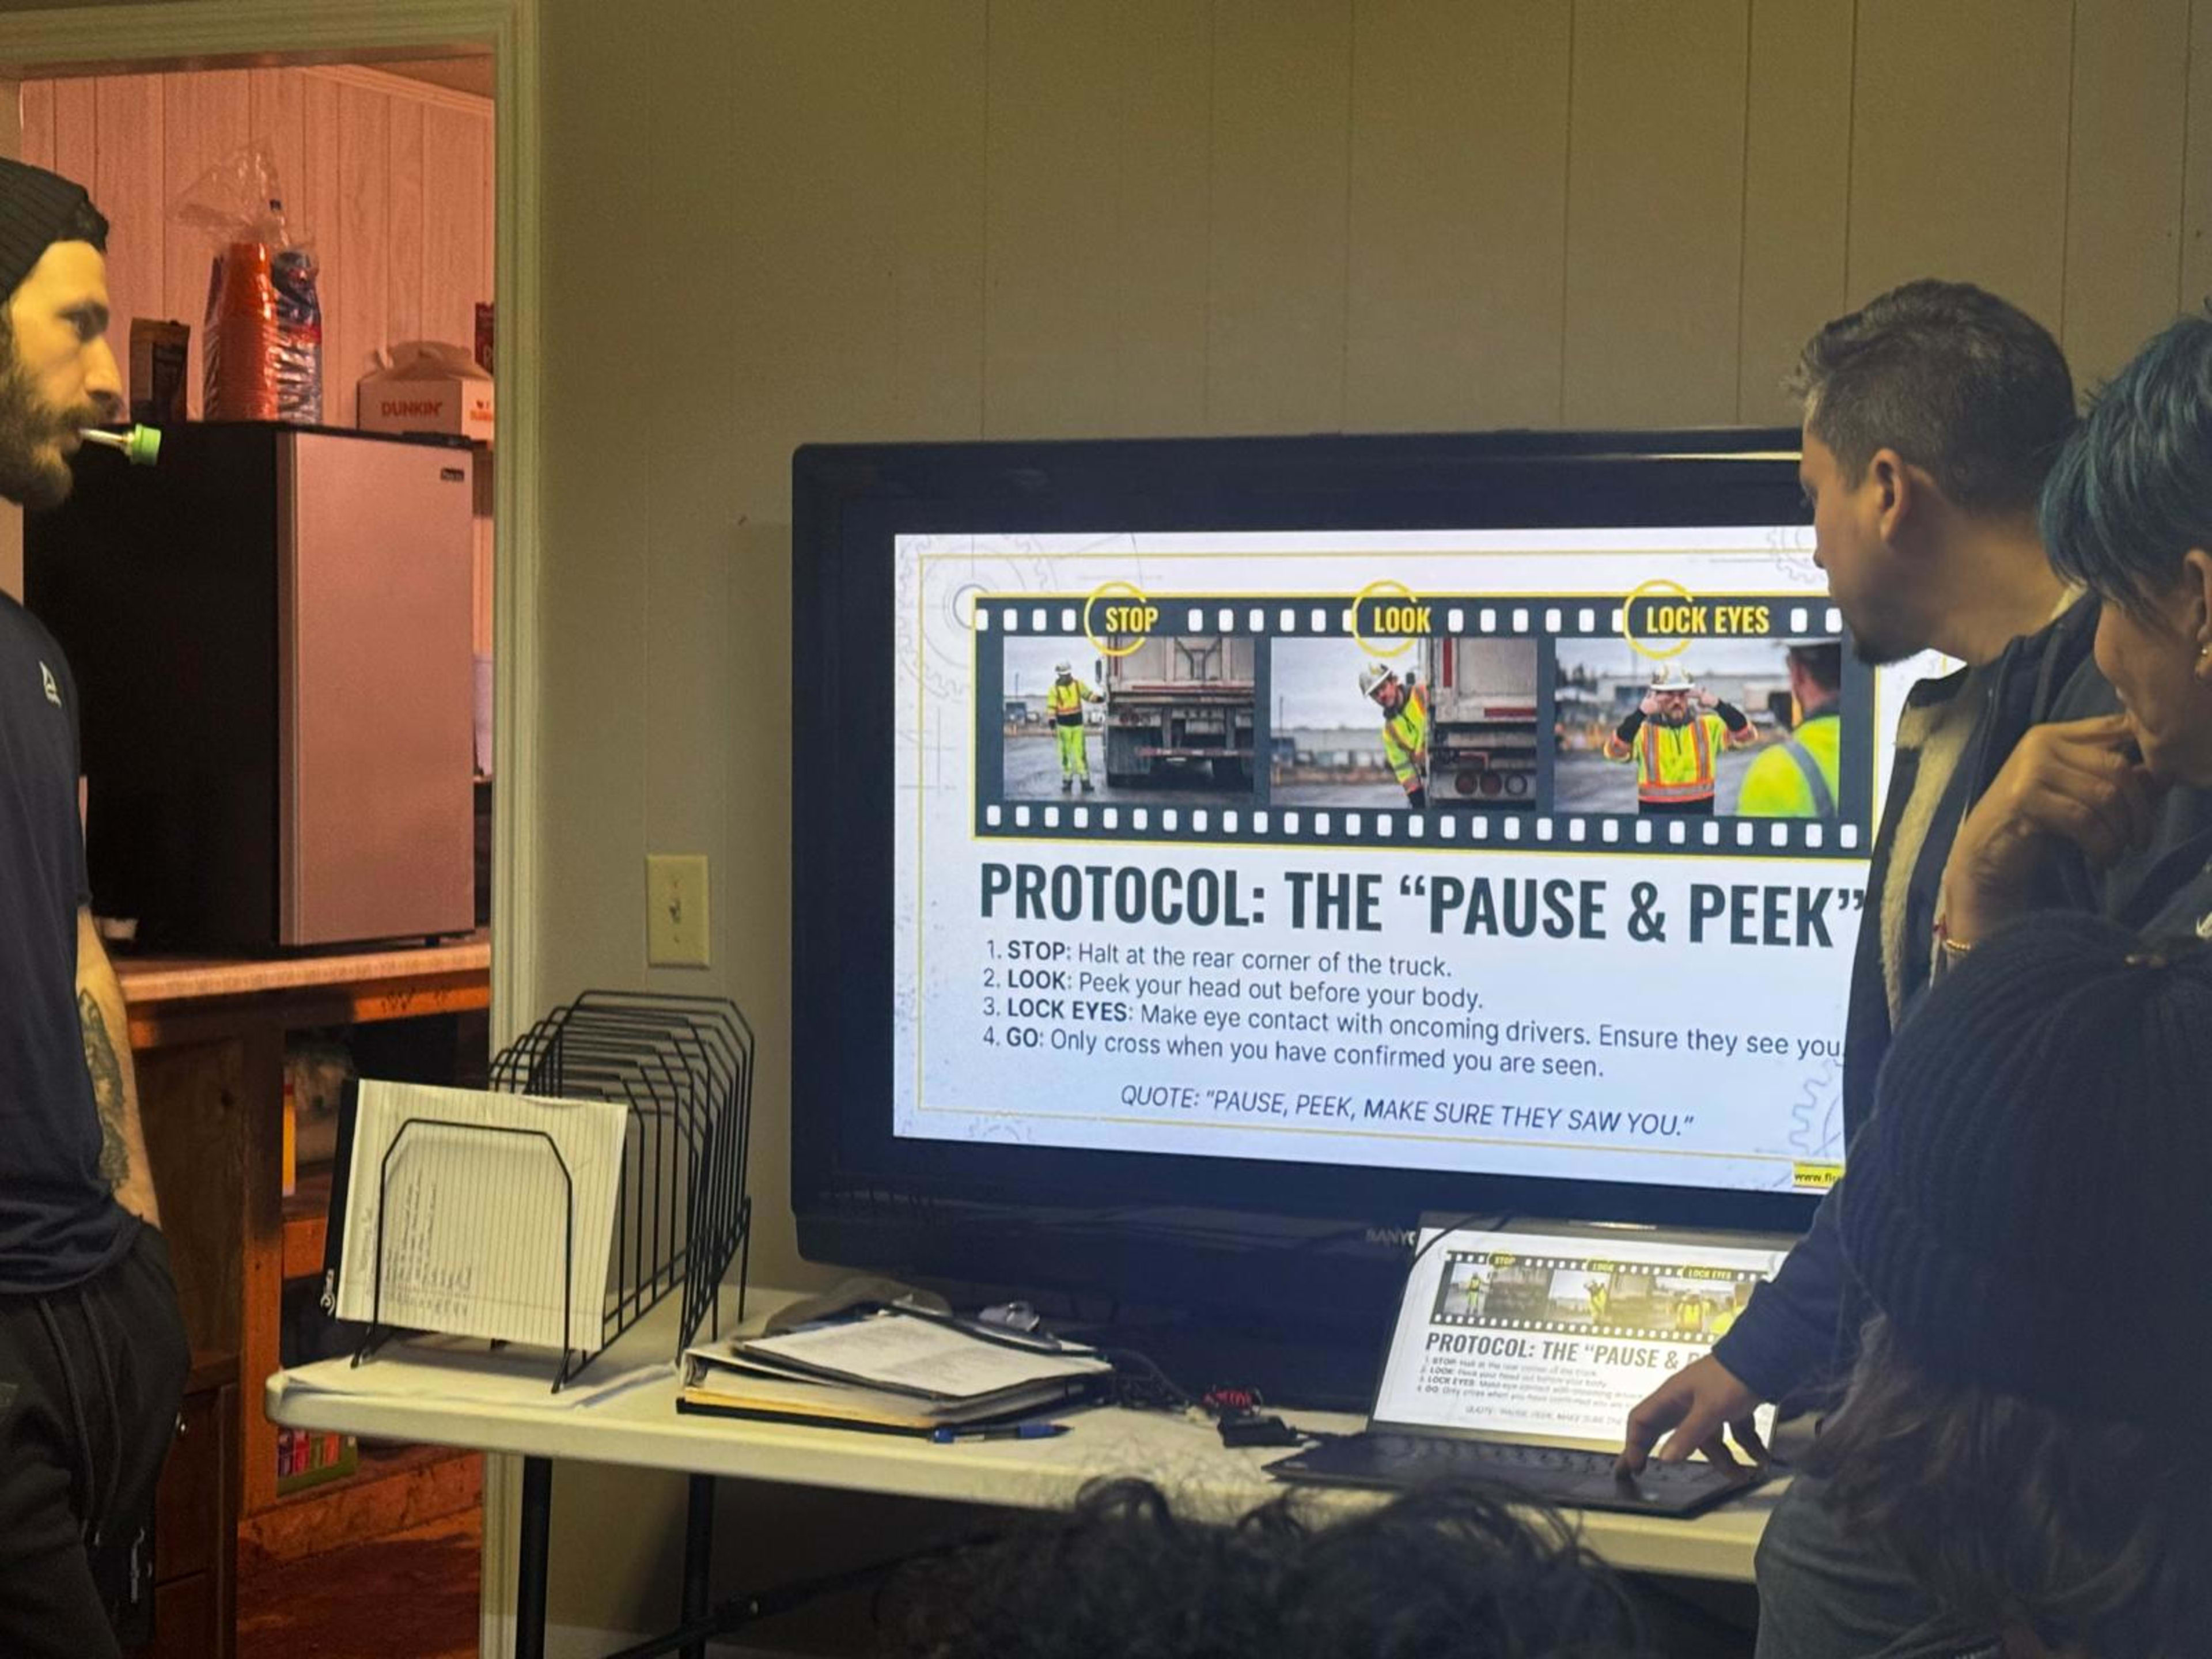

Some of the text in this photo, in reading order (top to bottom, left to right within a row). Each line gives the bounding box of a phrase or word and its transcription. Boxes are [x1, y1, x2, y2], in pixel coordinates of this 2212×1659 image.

[1108, 608, 1157, 631] STOP
[1375, 608, 1429, 632] LOOK
[1647, 607, 1768, 632] LOCK EYES
[982, 863, 1264, 926] PROTOCOL:
[1285, 872, 1382, 931] THE
[1400, 875, 1606, 939] “PAUSE
[1628, 881, 1665, 942] &
[987, 940, 1450, 976] 1. STOP: Halt at the rear corner of the truck.
[984, 968, 1482, 1013] 2. LOOK: Peek your head out before your body.
[983, 997, 1000, 1016] 3.
[1008, 998, 1064, 1019] LOCK
[1073, 1001, 1132, 1022] EYES:
[1142, 1004, 1196, 1025] Make
[1204, 1010, 1240, 1032] eye
[1248, 1012, 1328, 1032] contact
[1337, 1012, 1382, 1034] with
[1390, 1017, 1498, 1046] oncoming
[1506, 1020, 1590, 1045] drivers.
[1600, 1024, 1677, 1049] Ensure
[1688, 1029, 1737, 1056] they
[1747, 1036, 1789, 1054] see
[983, 1026, 1603, 1077] 4. GO: Only cross when you have confirmed you are seen.
[1122, 1085, 1199, 1108] QUOTE:
[1296, 1094, 1355, 1121] PEEK,
[1364, 1099, 1427, 1121] MAKE
[1434, 1102, 1494, 1125] SURE
[1502, 1105, 1562, 1128] THEY
[1568, 1110, 1622, 1131] SAW
[1425, 1332, 1536, 1358] PROTOCOL:
[1542, 1340, 1579, 1362] THE
[1664, 1350, 1679, 1370] &
